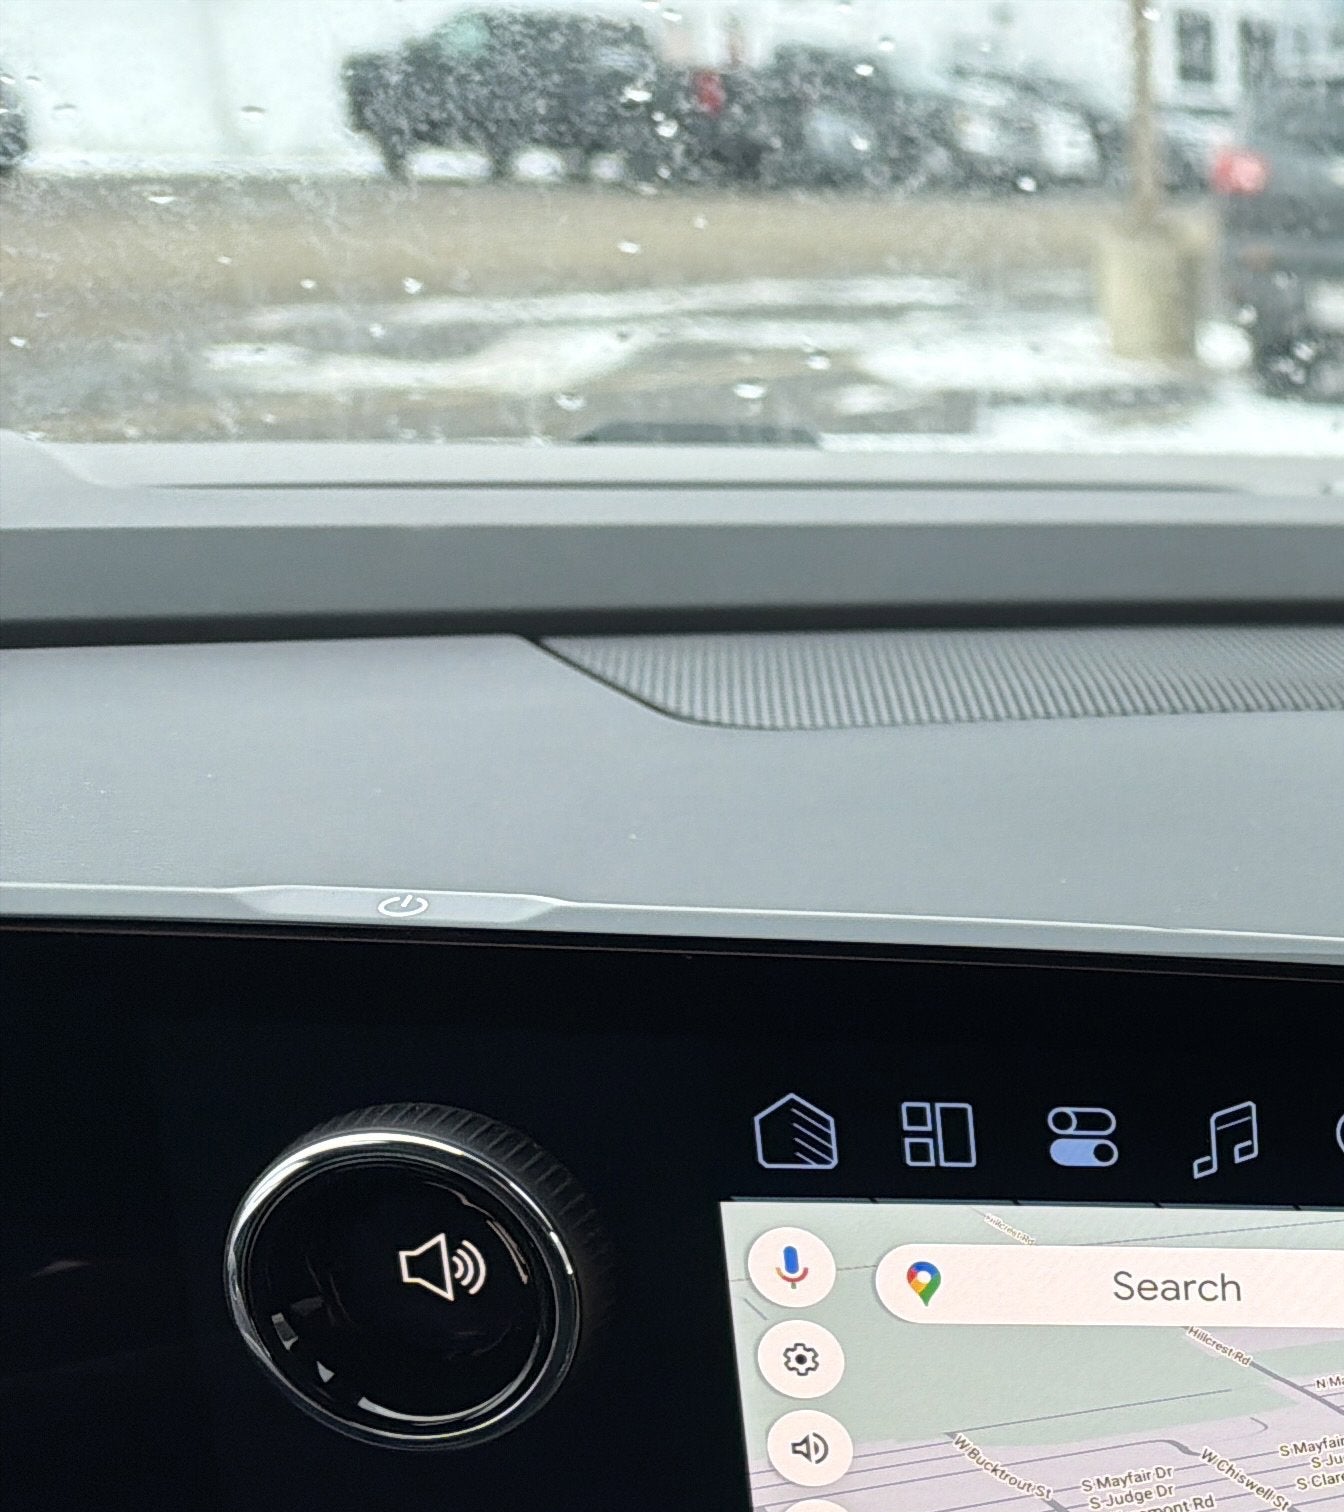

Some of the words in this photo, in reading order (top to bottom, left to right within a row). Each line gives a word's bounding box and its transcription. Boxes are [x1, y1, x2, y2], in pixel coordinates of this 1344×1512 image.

[1112, 1271, 1242, 1303] Search
[1188, 1327, 1233, 1358] Hillcrest
[1234, 1350, 1251, 1366] Rd
[1316, 1379, 1327, 1389] N
[1280, 1445, 1290, 1456] S
[1292, 1437, 1344, 1455] Mayfair
[954, 1435, 969, 1450] W
[967, 1447, 1034, 1497] Bucktrout
[1036, 1486, 1052, 1500] St
[1311, 1456, 1321, 1468] S
[1082, 1479, 1093, 1492] S
[1097, 1472, 1152, 1490] Mayfair
[1155, 1467, 1173, 1479] Dr
[1201, 1449, 1217, 1465] W
[1216, 1459, 1274, 1504] Chiswell
[1274, 1496, 1290, 1512] St
[1296, 1478, 1308, 1490] S
[1090, 1497, 1101, 1509] S
[1106, 1490, 1153, 1510] Judge
[1156, 1485, 1174, 1498] Dr
[1192, 1496, 1215, 1510] Rd
